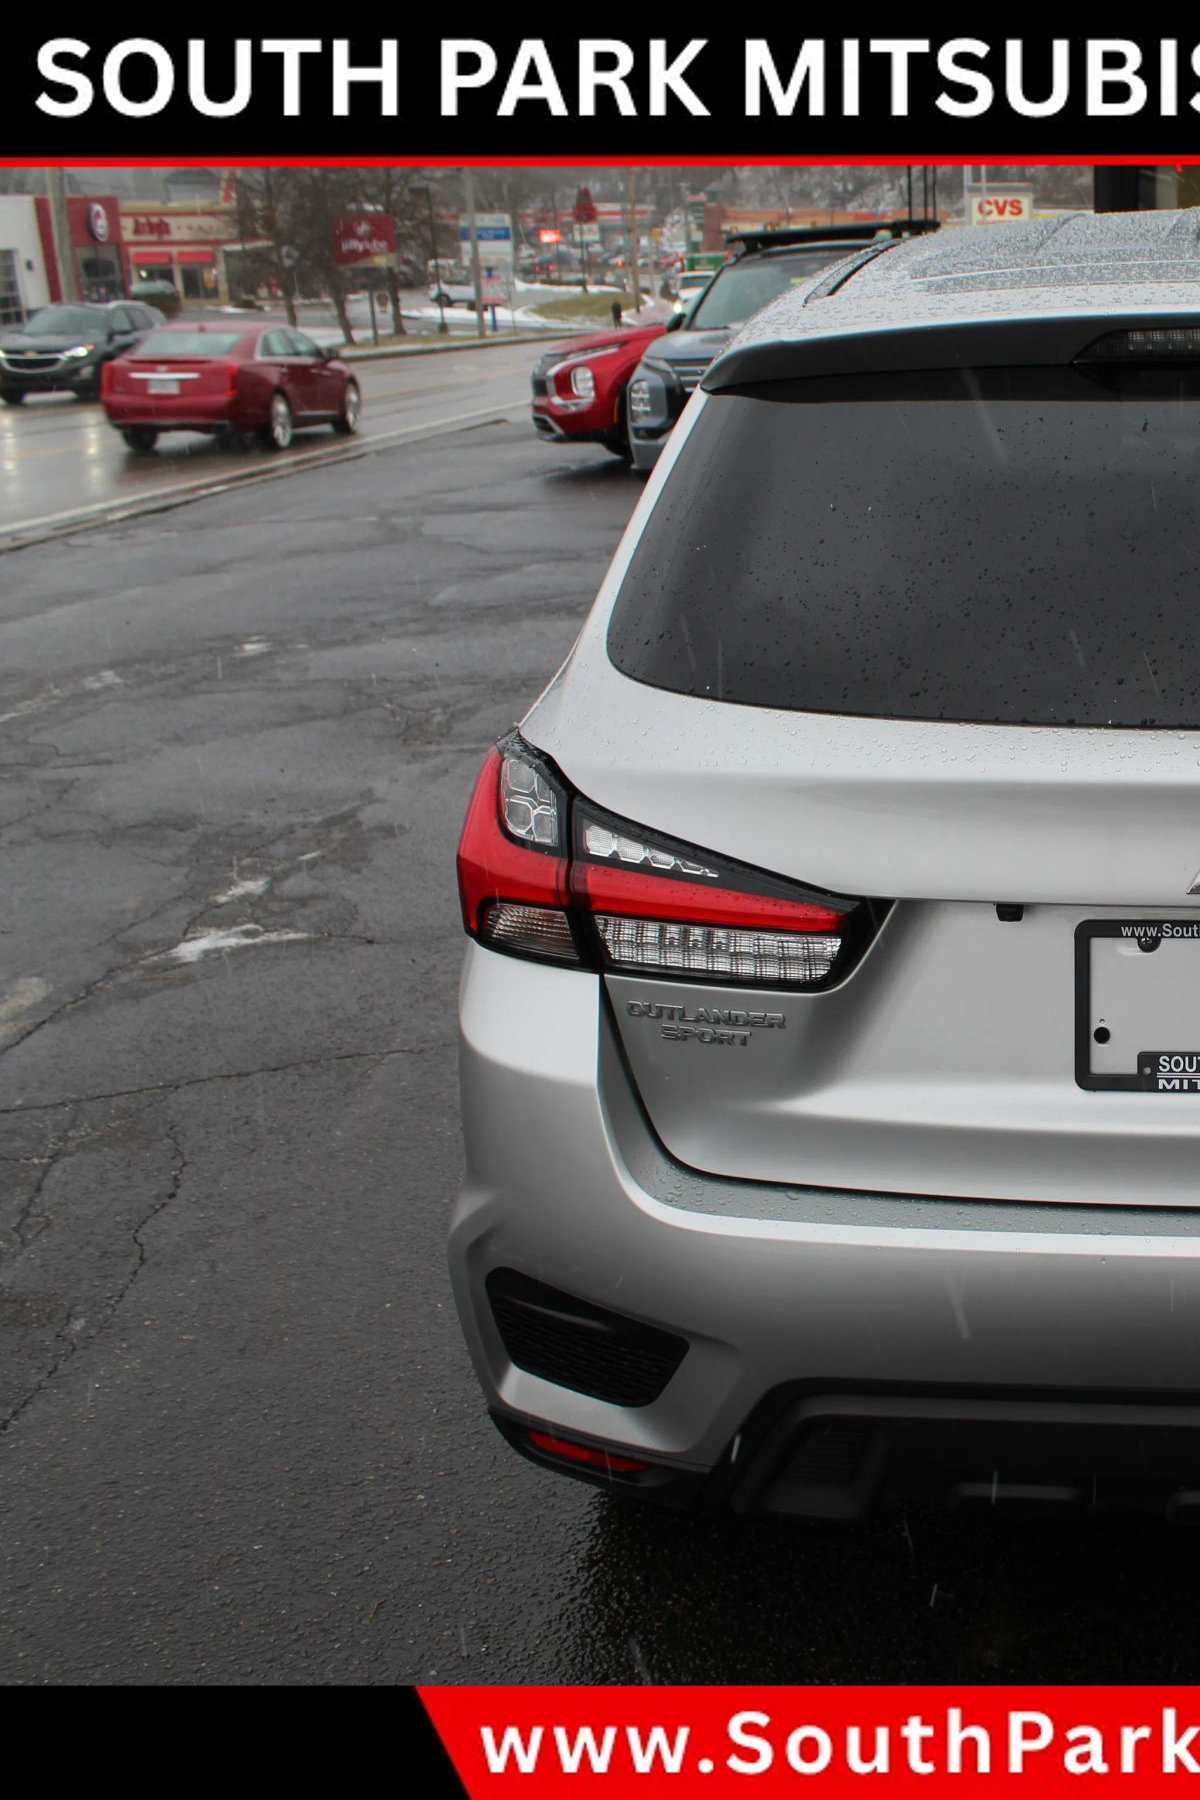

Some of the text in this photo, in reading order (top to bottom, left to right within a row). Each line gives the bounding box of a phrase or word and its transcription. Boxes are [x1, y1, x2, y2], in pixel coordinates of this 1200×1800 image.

[977, 198, 1023, 216] CVS
[627, 1000, 786, 1029] OUTLANDER
[661, 1024, 751, 1047] SPORT
